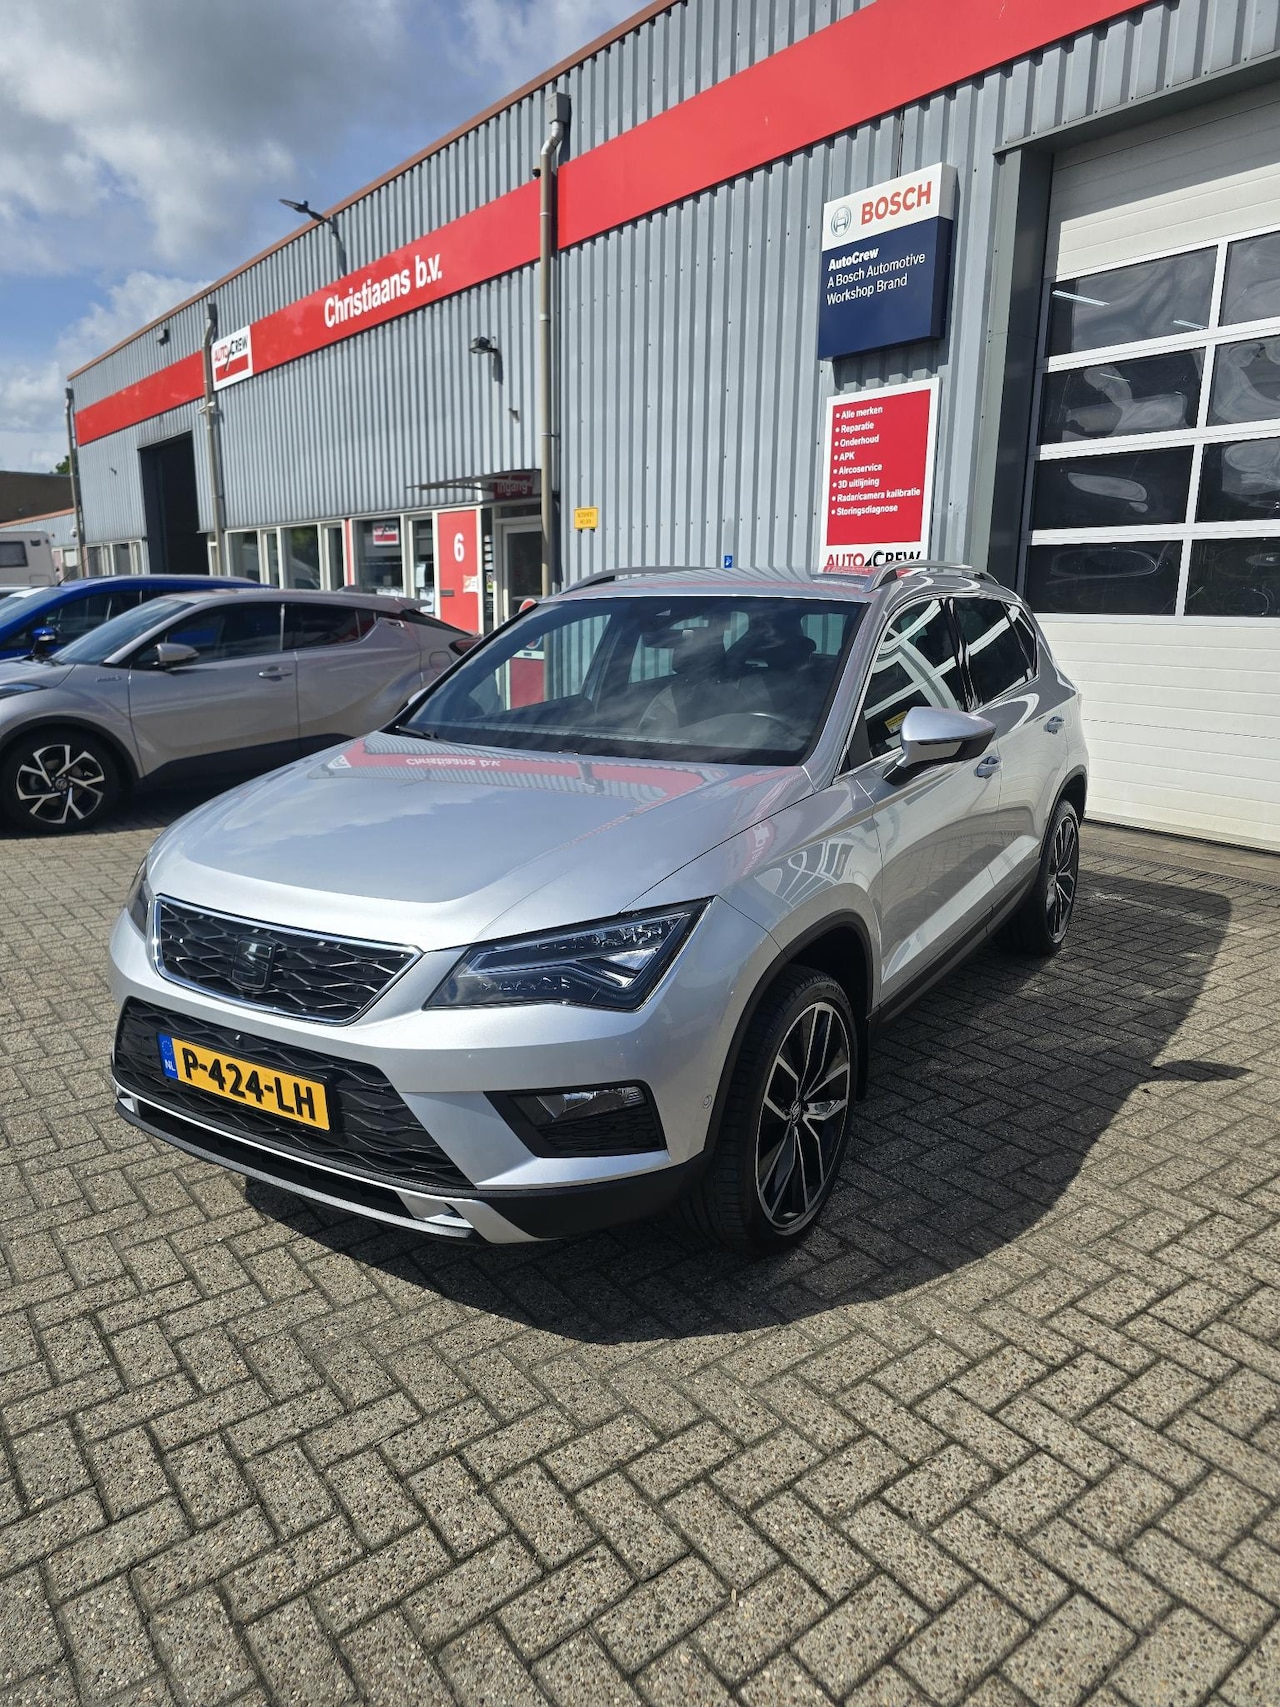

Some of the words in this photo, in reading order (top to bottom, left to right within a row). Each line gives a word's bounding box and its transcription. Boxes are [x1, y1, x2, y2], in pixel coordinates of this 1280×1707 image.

[861, 181, 931, 225] BOSCH
[828, 247, 879, 272] AutoCrew
[827, 277, 835, 289] A
[835, 266, 865, 286] Bosch
[866, 252, 925, 277] Automotive
[324, 268, 410, 328] Christiaans
[415, 253, 443, 289] b.v.
[827, 283, 874, 305] Workshop
[876, 273, 908, 293] Brand
[841, 410, 855, 419] Alle
[856, 406, 883, 417] merken
[840, 421, 874, 434] Reparatie
[840, 434, 880, 448] Onderhoud
[839, 451, 855, 461] APK
[838, 463, 883, 475] Aircoservice
[497, 480, 527, 496] Ingang
[838, 479, 848, 489] 3D
[848, 477, 880, 489] uitlijning
[837, 491, 885, 503] Radar/camera
[886, 487, 921, 498] kalibratie
[836, 504, 899, 517] Storingsdiagnose
[453, 532, 465, 562] 6
[164, 1059, 175, 1071] NL
[183, 1048, 315, 1121] P-424-LH
